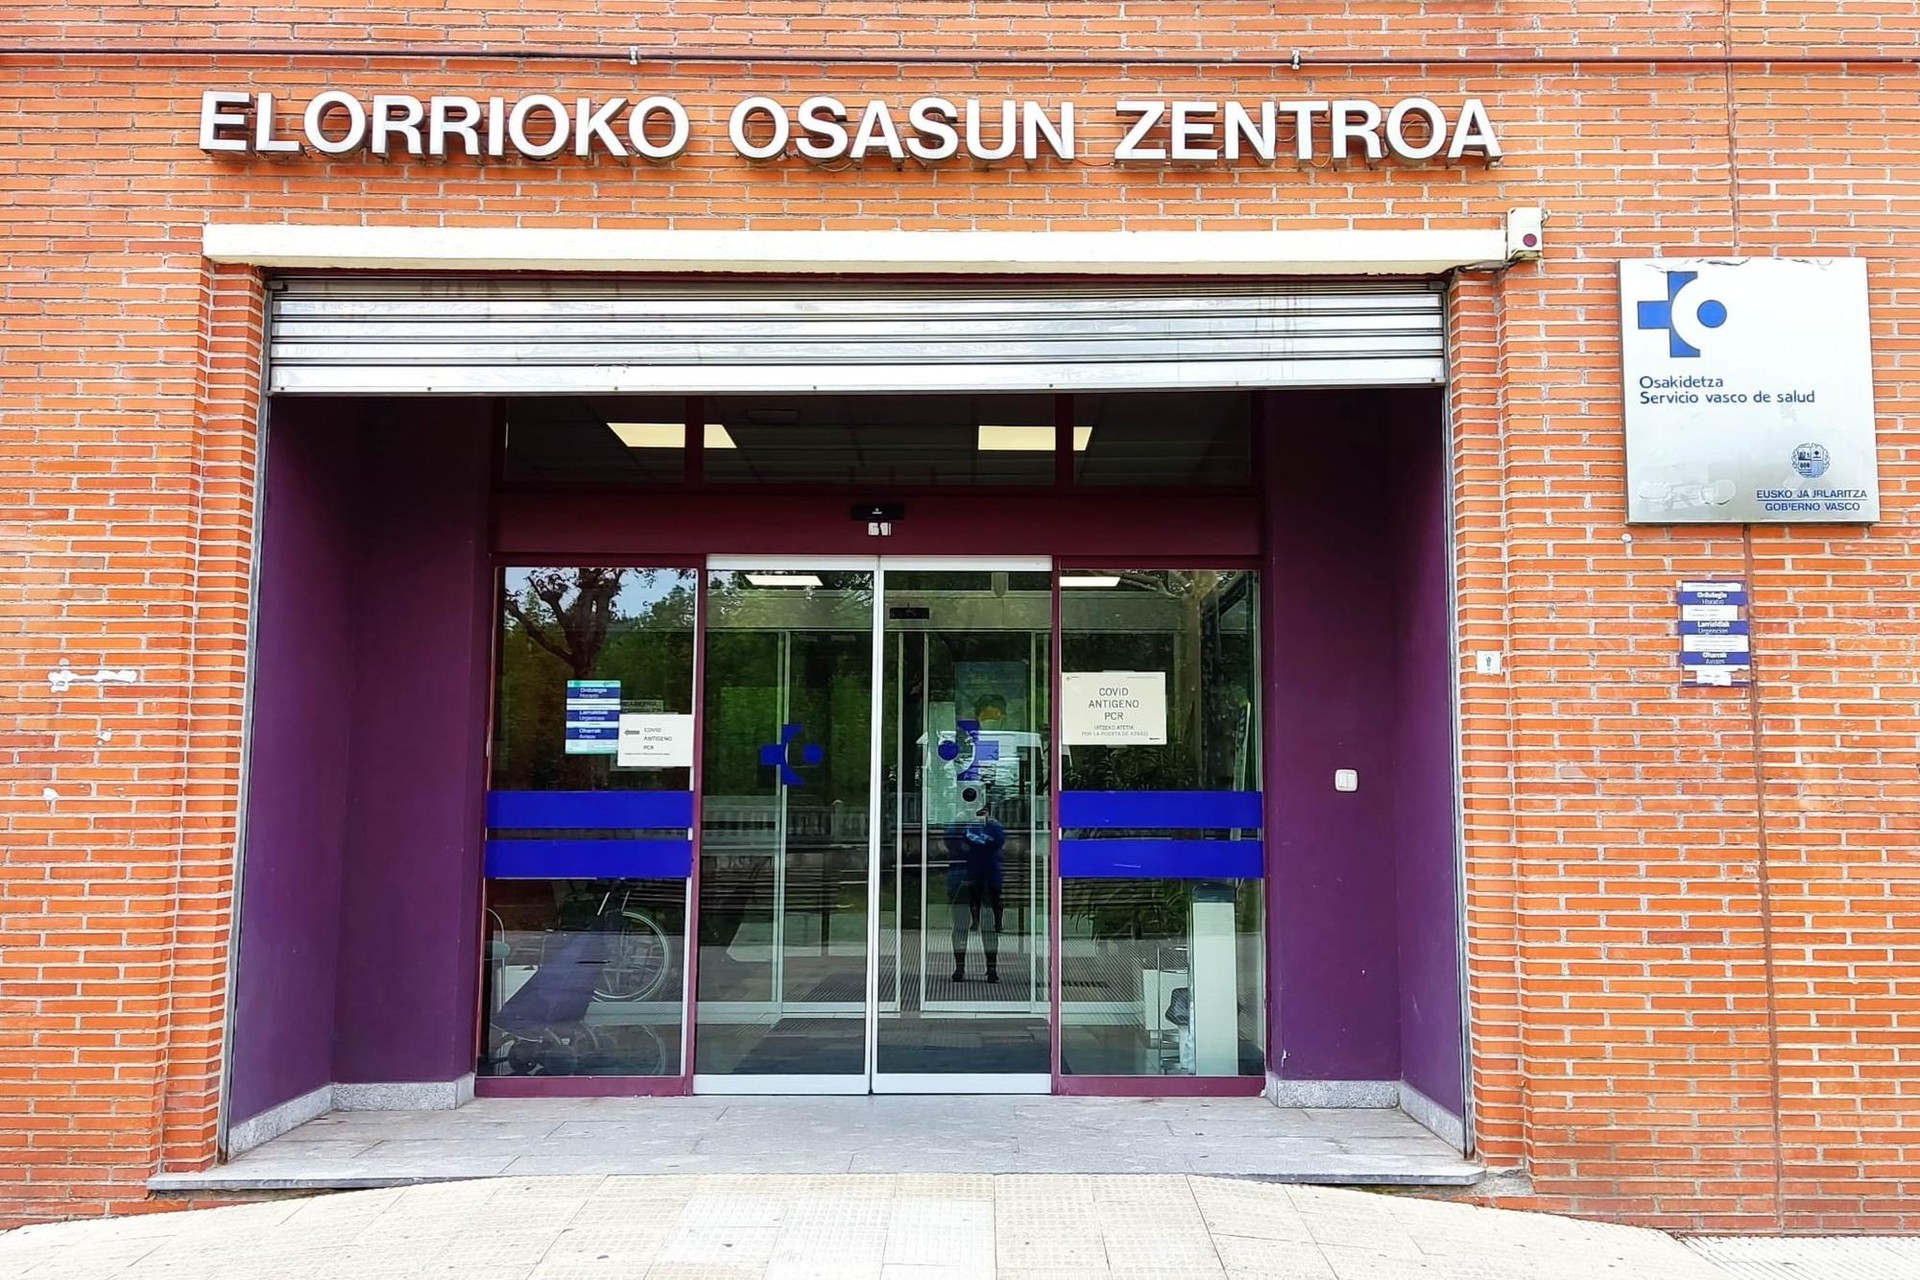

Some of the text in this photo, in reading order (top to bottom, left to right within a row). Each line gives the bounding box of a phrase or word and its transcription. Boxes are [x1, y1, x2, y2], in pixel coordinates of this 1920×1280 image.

[199, 91, 1503, 165] ELORRIOKO OSASUN ZENTROA
[1639, 375, 1724, 389] Osakidetza
[1639, 390, 1816, 404] Servicio vasco de salud
[1756, 489, 1793, 499] EUSKO
[1765, 502, 1861, 512] GOBIERNO VASCO
[1098, 687, 1129, 697] COVID
[1088, 699, 1140, 709] ANTIGENO
[1104, 711, 1124, 721] PCR
